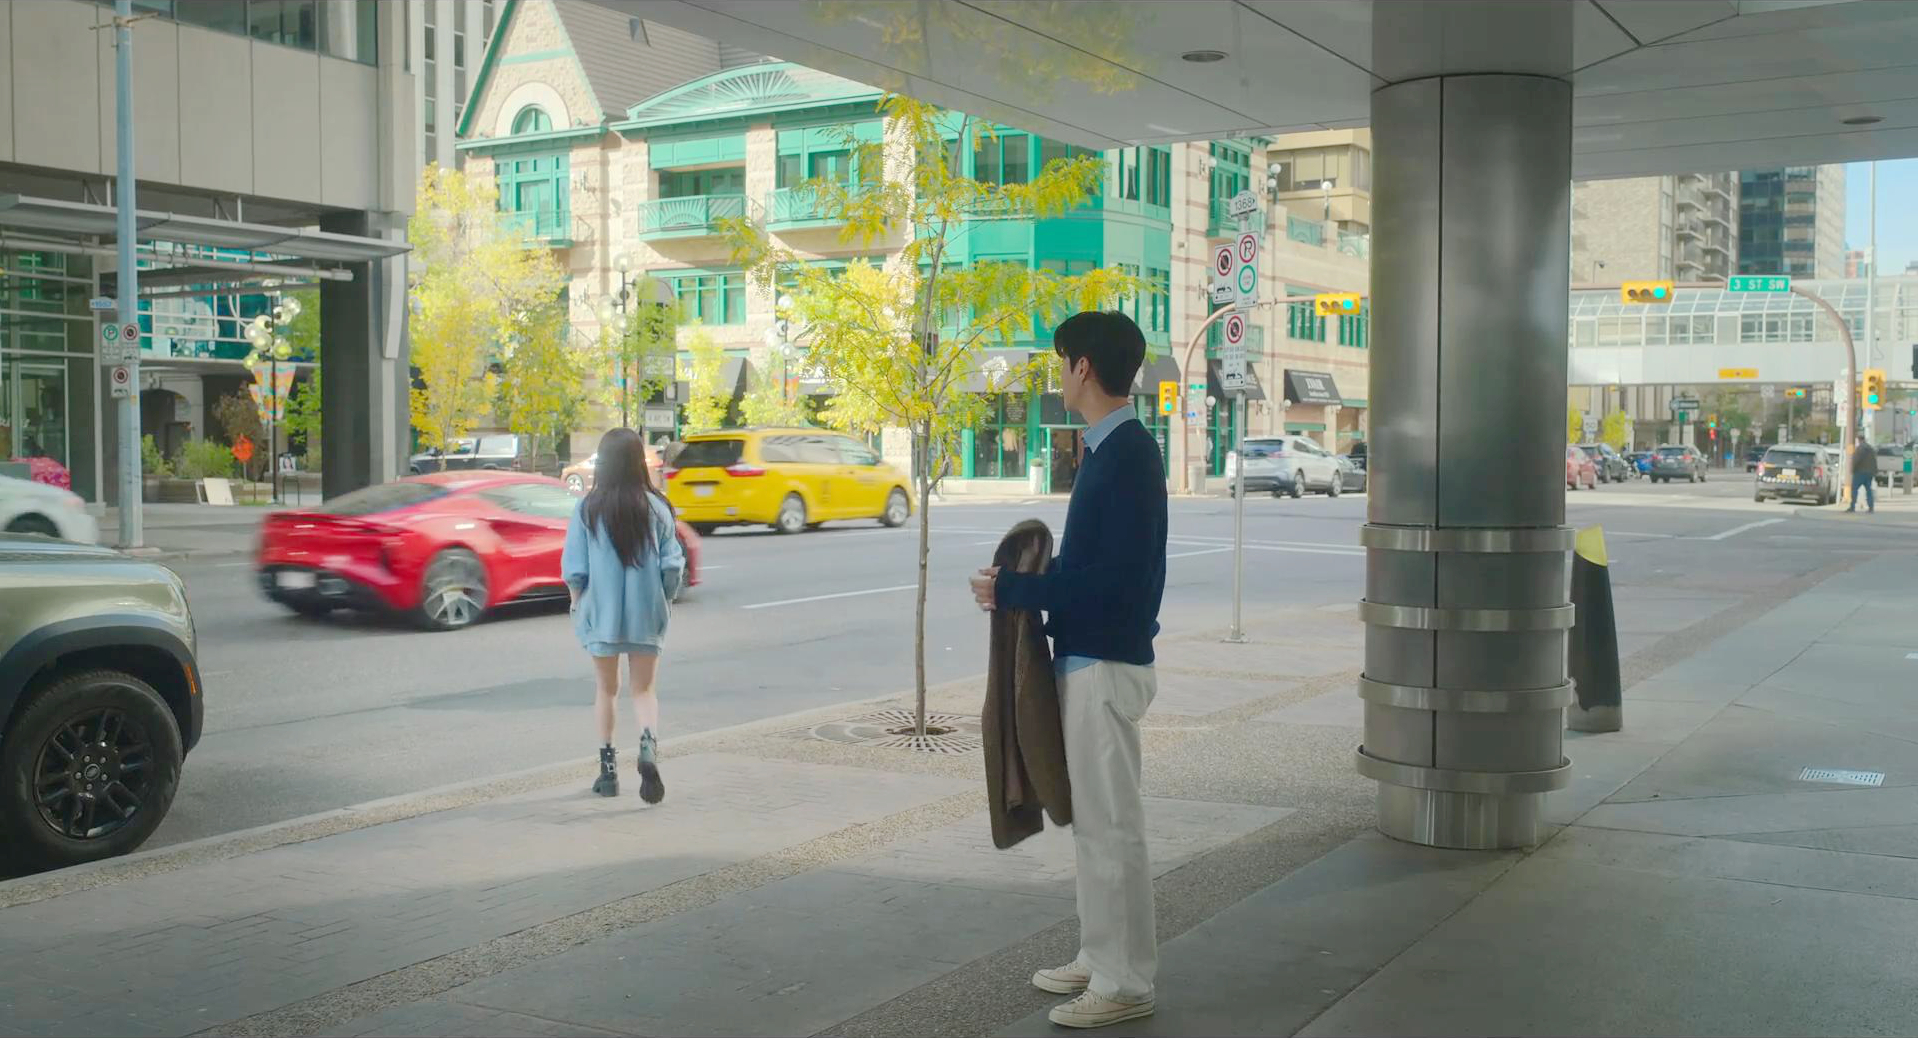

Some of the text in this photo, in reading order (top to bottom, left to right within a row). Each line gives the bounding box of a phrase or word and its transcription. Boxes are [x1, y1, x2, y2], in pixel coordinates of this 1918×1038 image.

[1235, 196, 1252, 211] 1368
[1733, 278, 1786, 291] 3 ST SW
